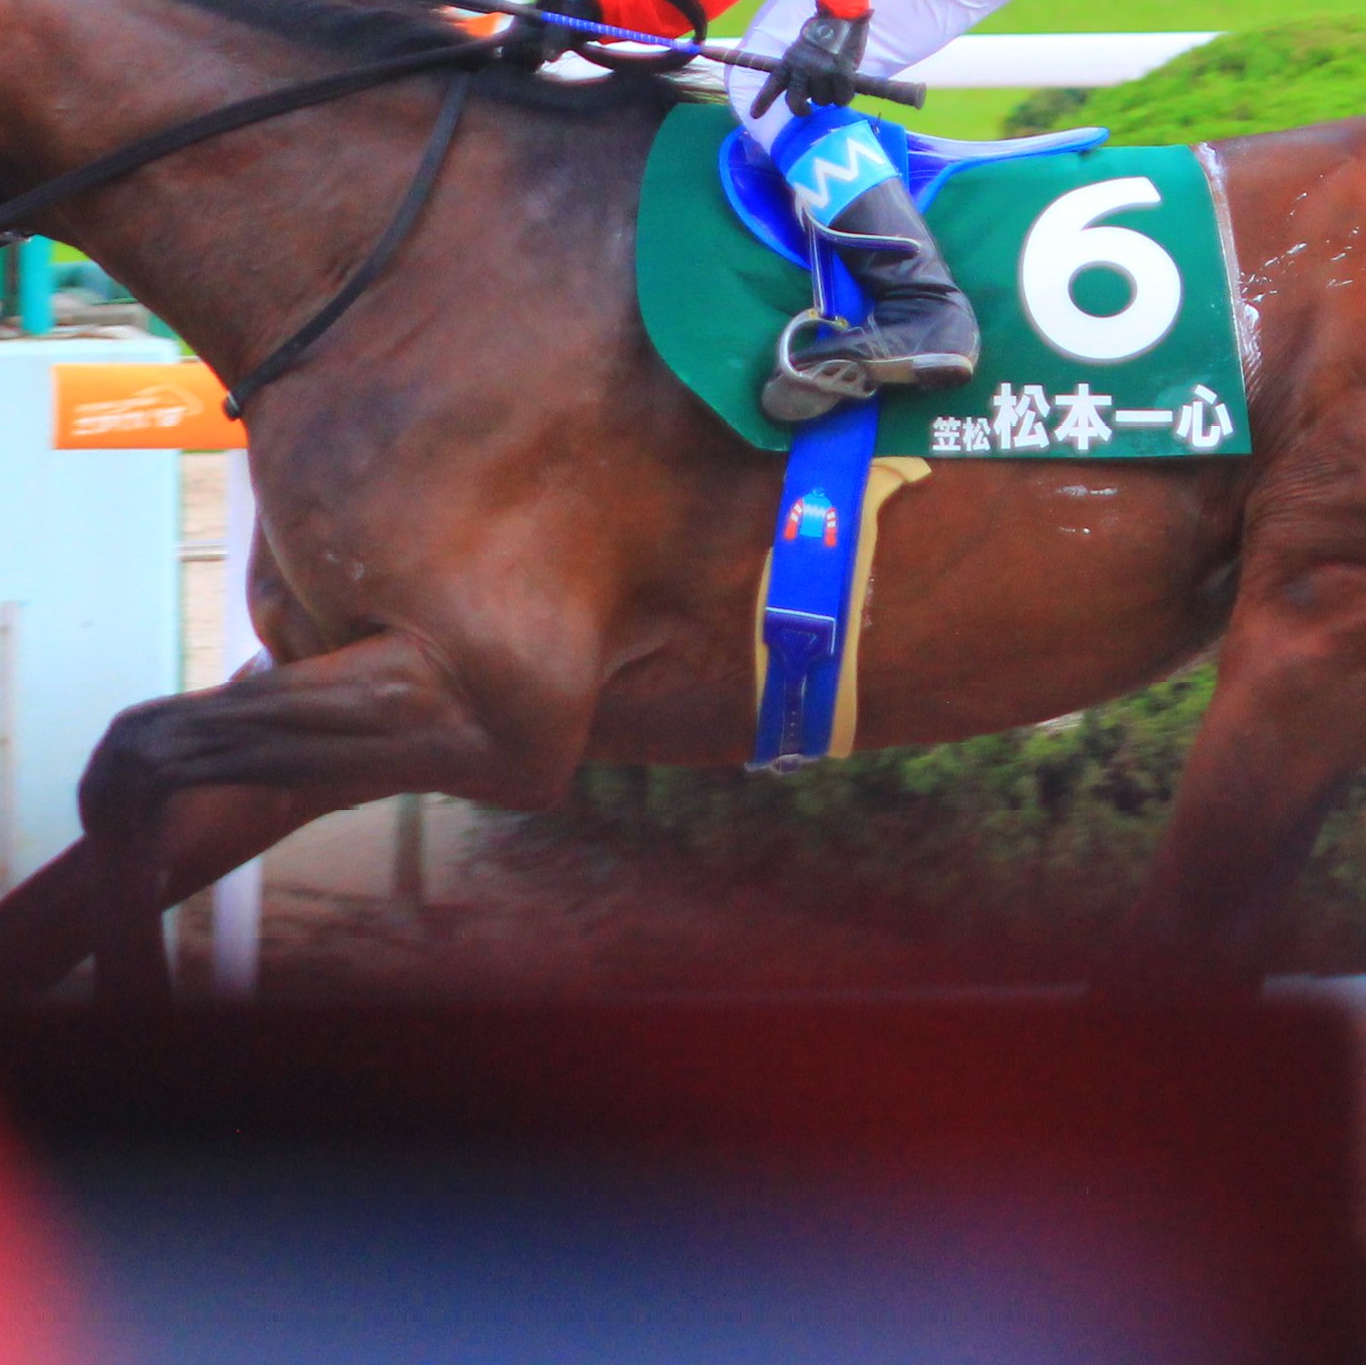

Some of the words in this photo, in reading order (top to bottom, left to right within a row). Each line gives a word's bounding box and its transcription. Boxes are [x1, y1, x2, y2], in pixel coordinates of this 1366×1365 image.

[1020, 175, 1182, 361] 6
[932, 416, 991, 452] 笠松
[992, 382, 1234, 451] 松本一心
